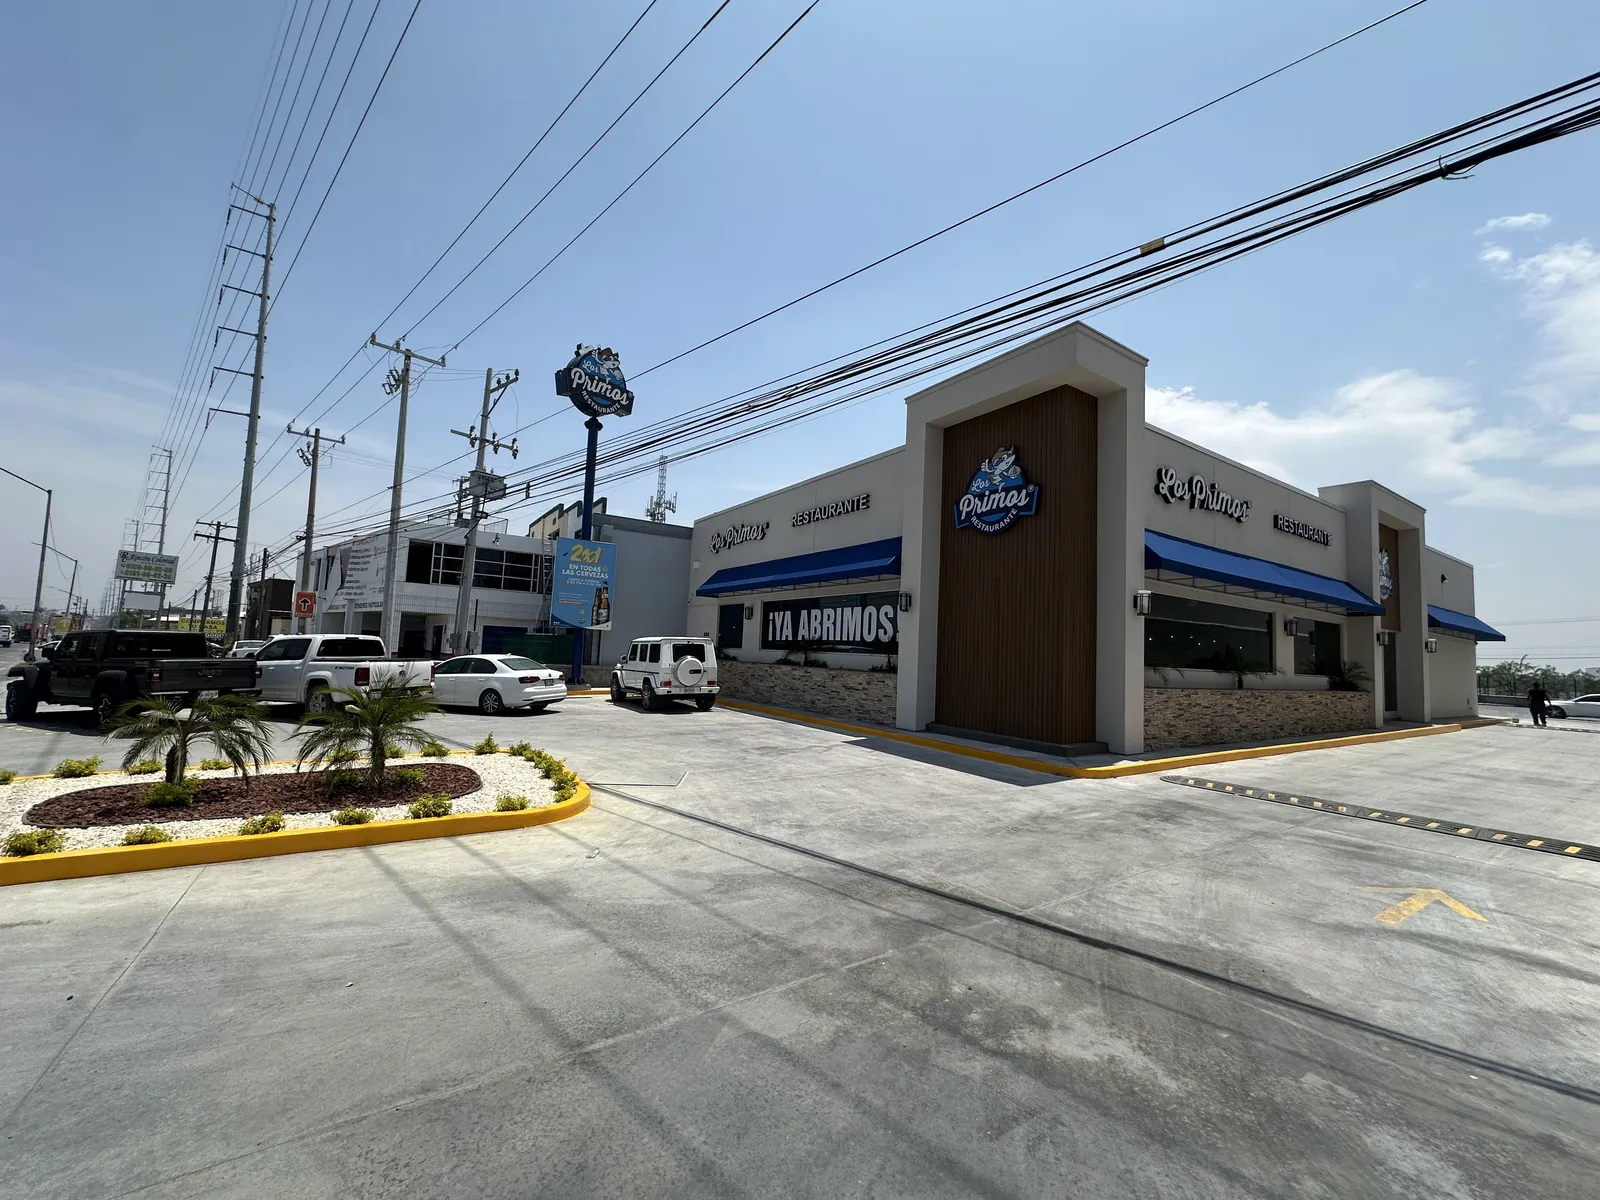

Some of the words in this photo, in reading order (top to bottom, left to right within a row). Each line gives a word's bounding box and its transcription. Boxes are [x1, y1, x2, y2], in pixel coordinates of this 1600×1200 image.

[582, 359, 600, 373] Los
[570, 367, 629, 405] Primos
[581, 390, 621, 414] RESTAURANTE
[970, 478, 990, 493] Los
[1158, 467, 1191, 504] Los
[1191, 474, 1249, 523] Primos
[790, 494, 869, 527] RESTAURANTE
[959, 488, 1030, 521] Primos
[970, 507, 1018, 533] RESTAURANTE
[1276, 514, 1333, 547] RESTAURANTE
[709, 533, 724, 554] Los
[725, 524, 765, 550] Primos
[151, 555, 177, 565] Colonial
[568, 563, 579, 571] EN
[579, 564, 602, 573] TODAS
[561, 568, 575, 577] LAS
[575, 570, 609, 579] CERVEZAS
[768, 610, 793, 641] ¡YA
[197, 668, 223, 677] Jeep
